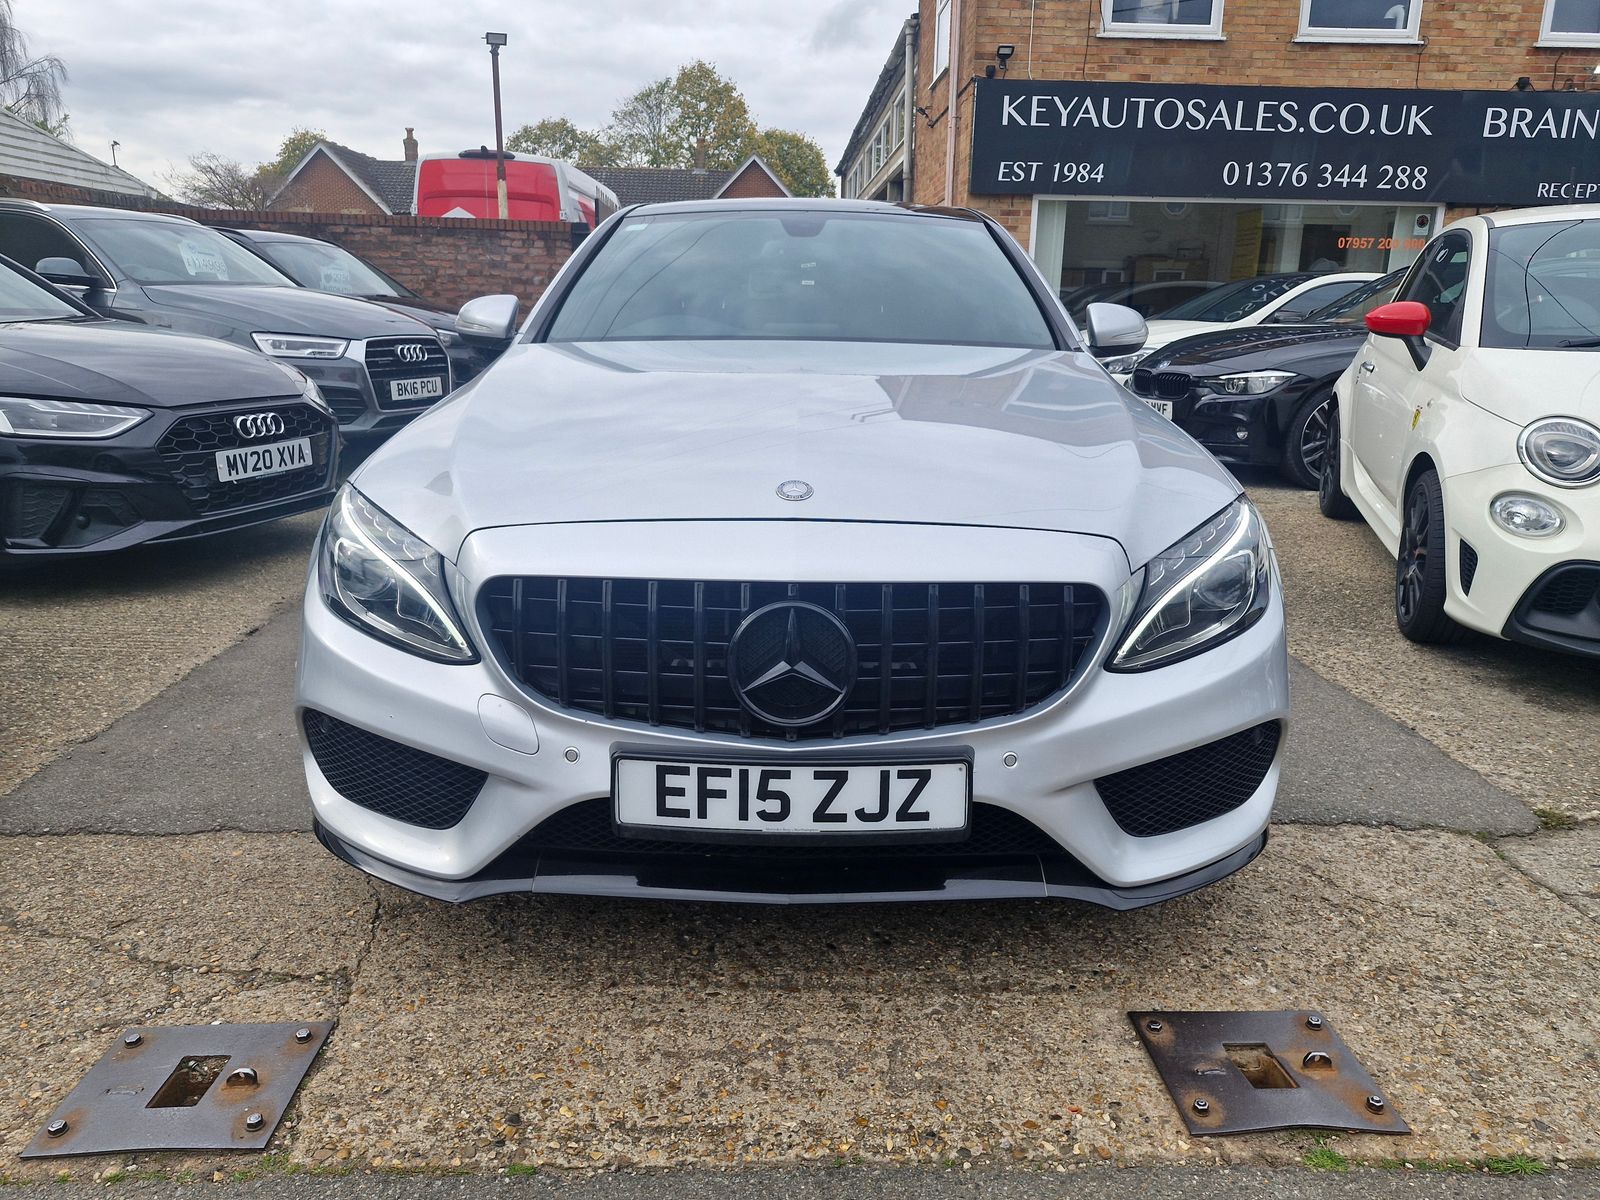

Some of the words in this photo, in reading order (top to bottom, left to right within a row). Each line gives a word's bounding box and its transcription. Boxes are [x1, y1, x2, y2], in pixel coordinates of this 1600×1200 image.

[1001, 95, 1434, 136] KEYAUTOSALES.CO.UK
[1482, 107, 1600, 140] BRAIN
[997, 161, 1043, 182] EST
[1053, 162, 1105, 183] 1984
[1222, 161, 1309, 187] 01376
[1316, 163, 1368, 189] 344
[1376, 165, 1428, 190] 288
[1537, 182, 1600, 199] RECEP
[1338, 237, 1375, 249] 07957
[397, 382, 419, 397] BK16
[420, 380, 438, 395] PCU
[226, 449, 273, 477] MV20
[277, 443, 306, 468] XVA
[656, 764, 792, 823] EF15
[812, 769, 932, 823] ZJZ
